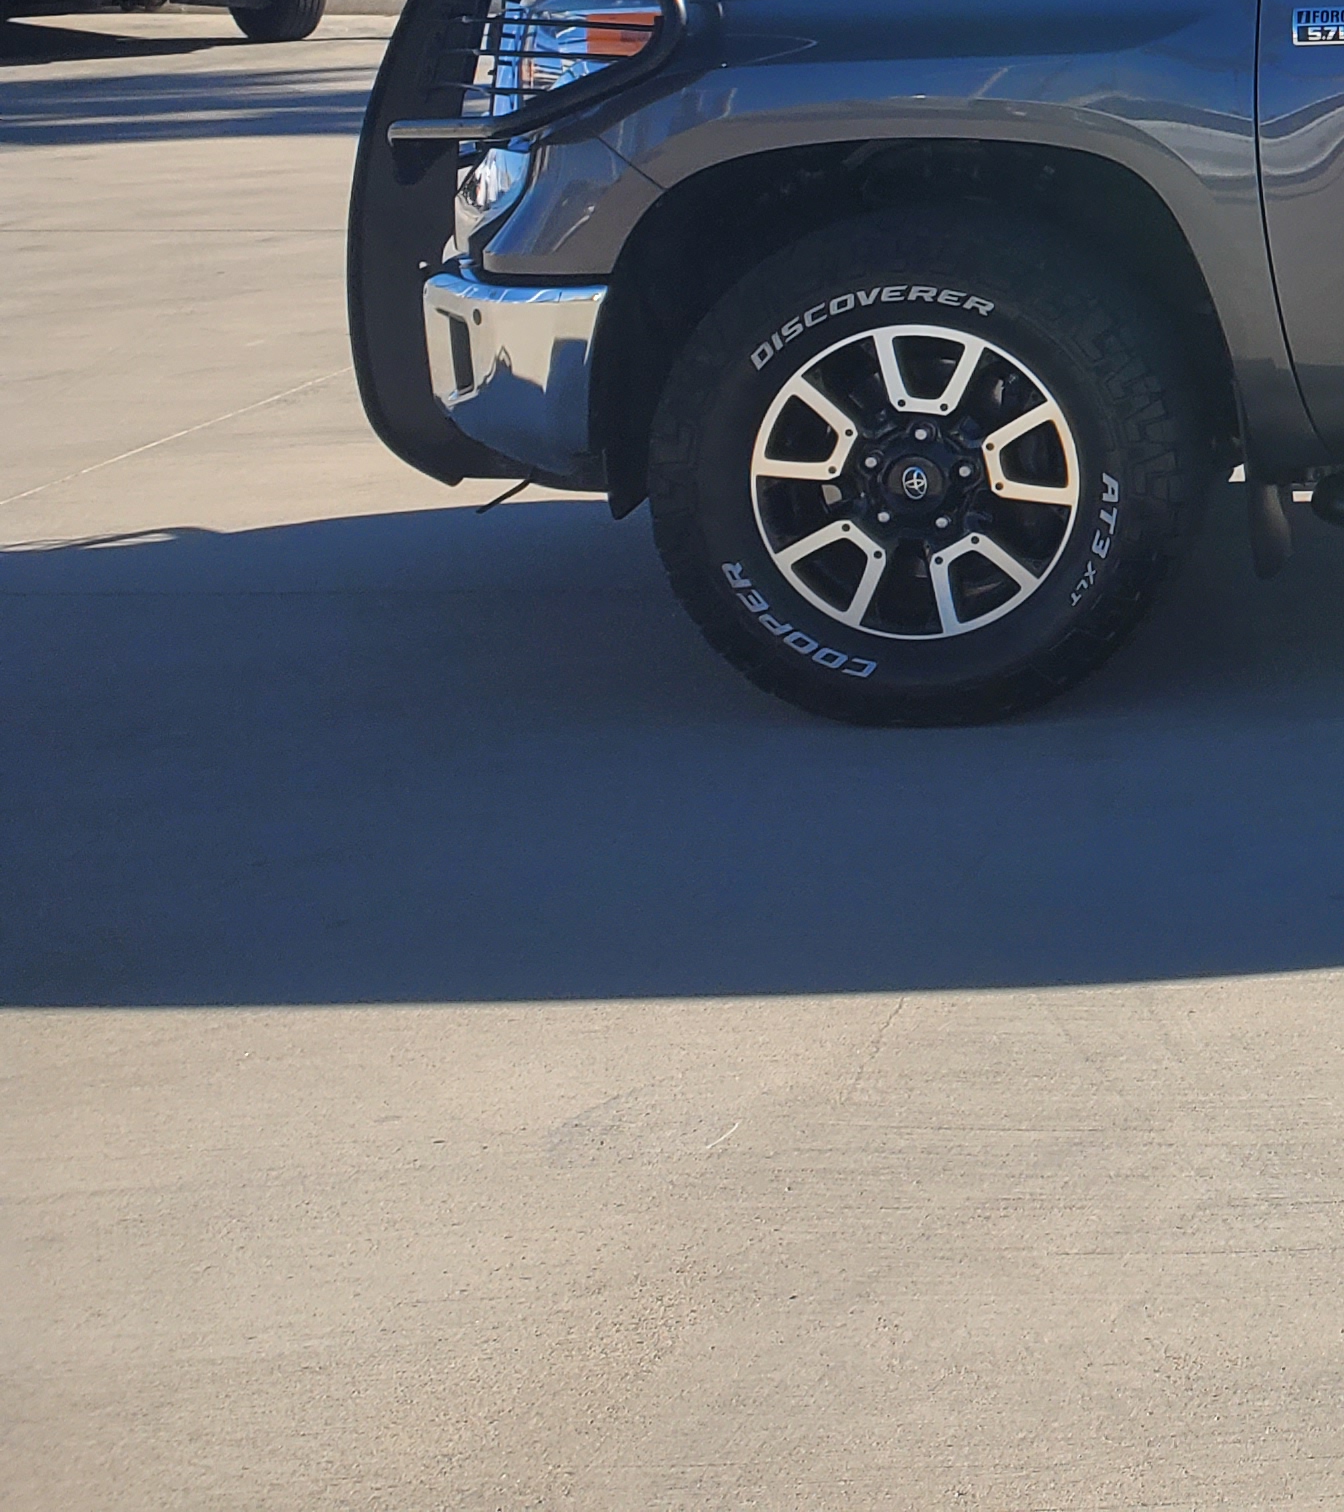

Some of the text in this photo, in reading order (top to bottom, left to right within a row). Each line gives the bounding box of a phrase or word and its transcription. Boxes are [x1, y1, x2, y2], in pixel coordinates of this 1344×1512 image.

[750, 285, 995, 371] DISCOVERER
[1071, 472, 1118, 606] AT3 XLT
[721, 562, 877, 677] COOPER
